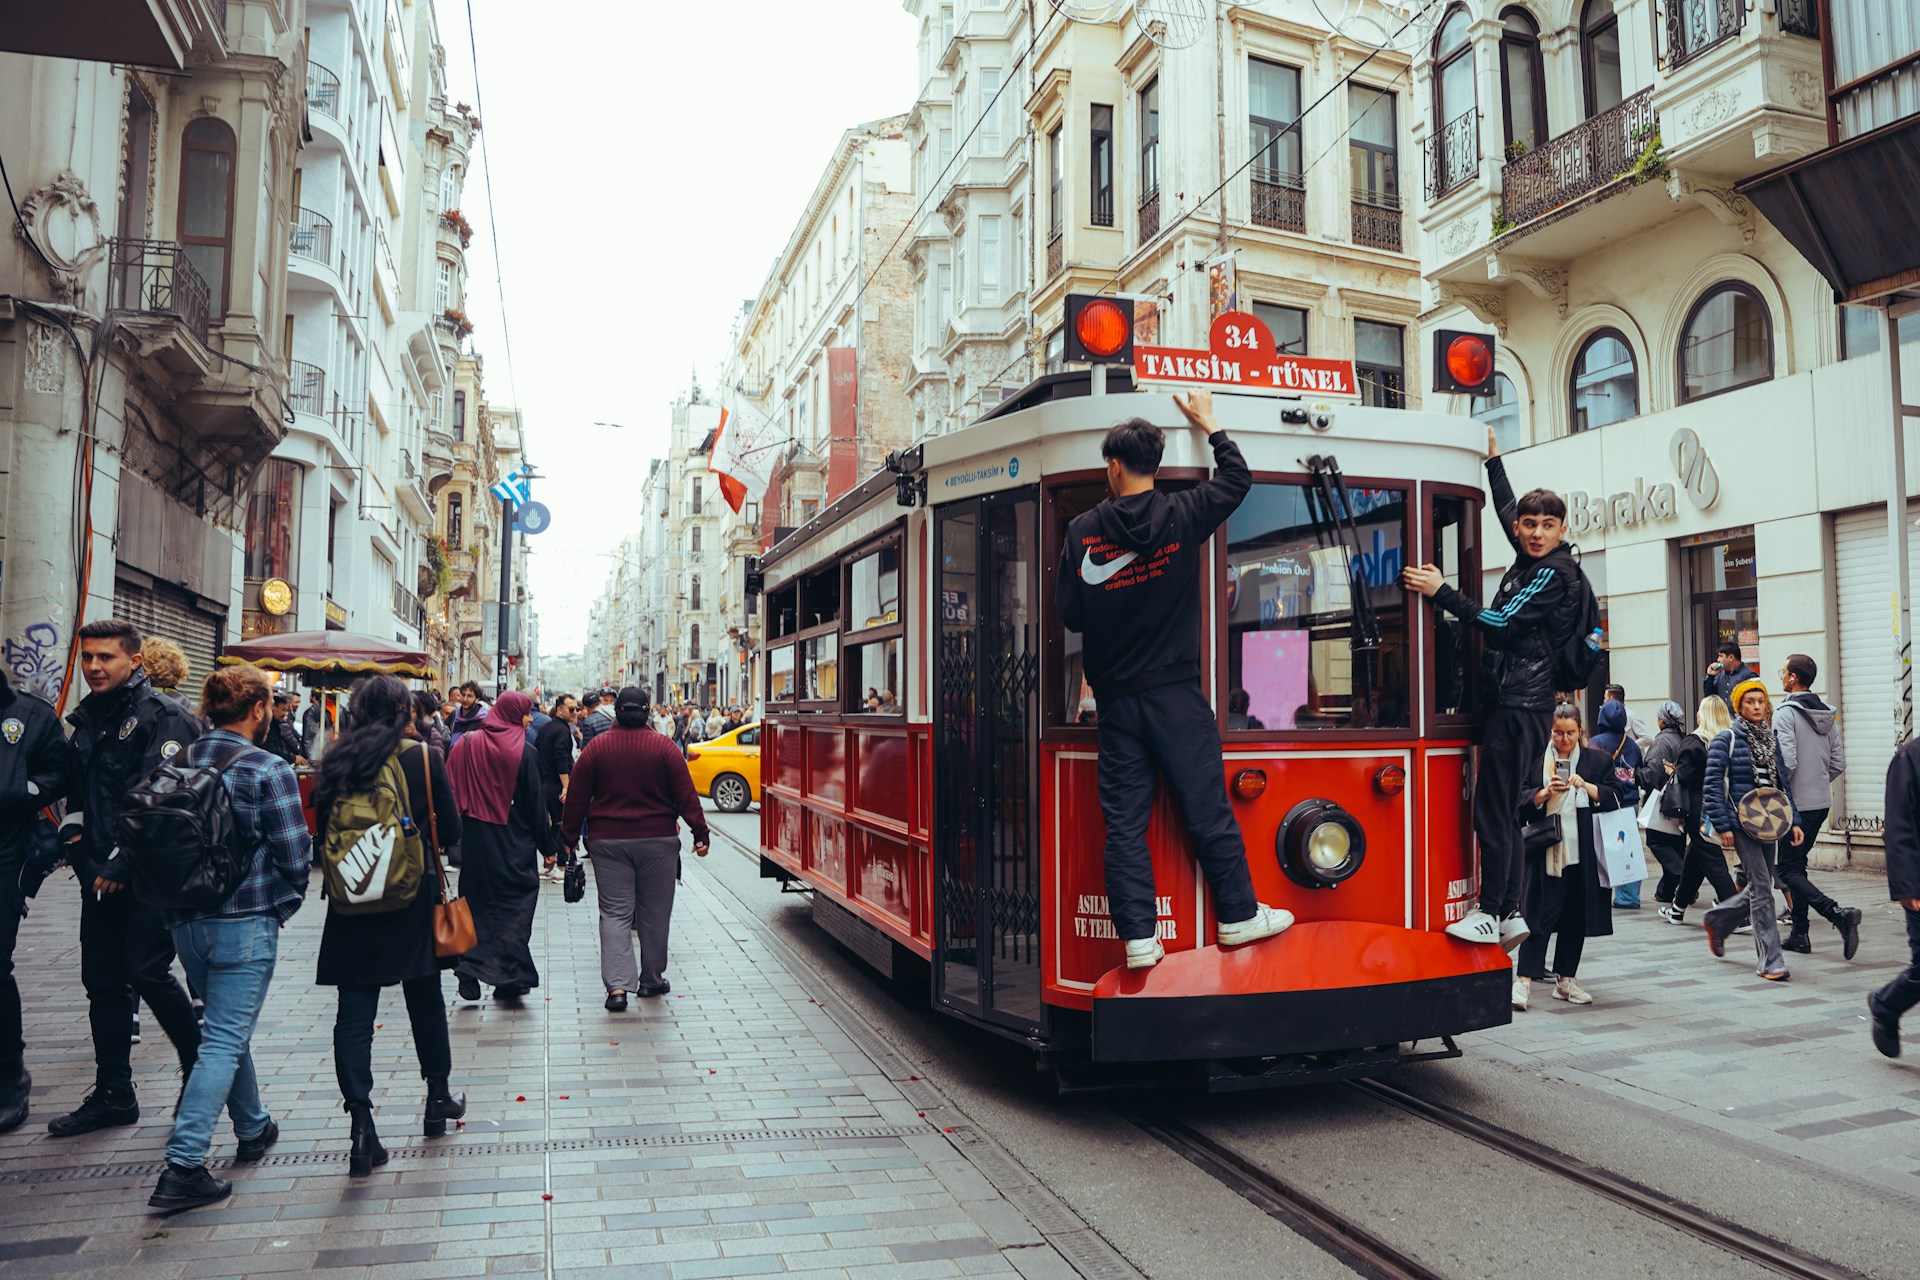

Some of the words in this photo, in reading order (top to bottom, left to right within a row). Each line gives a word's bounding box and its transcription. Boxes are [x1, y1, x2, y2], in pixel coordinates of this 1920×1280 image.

[1224, 325, 1259, 349] 34
[1142, 353, 1242, 383] TAKSİM
[1267, 360, 1347, 392] TÜNEL
[1081, 535, 1102, 546] Nike
[1148, 556, 1170, 570] sport
[1105, 577, 1136, 591] crafted
[1136, 574, 1149, 583] for
[1077, 895, 1111, 916] ASILM
[1074, 917, 1087, 937] VE
